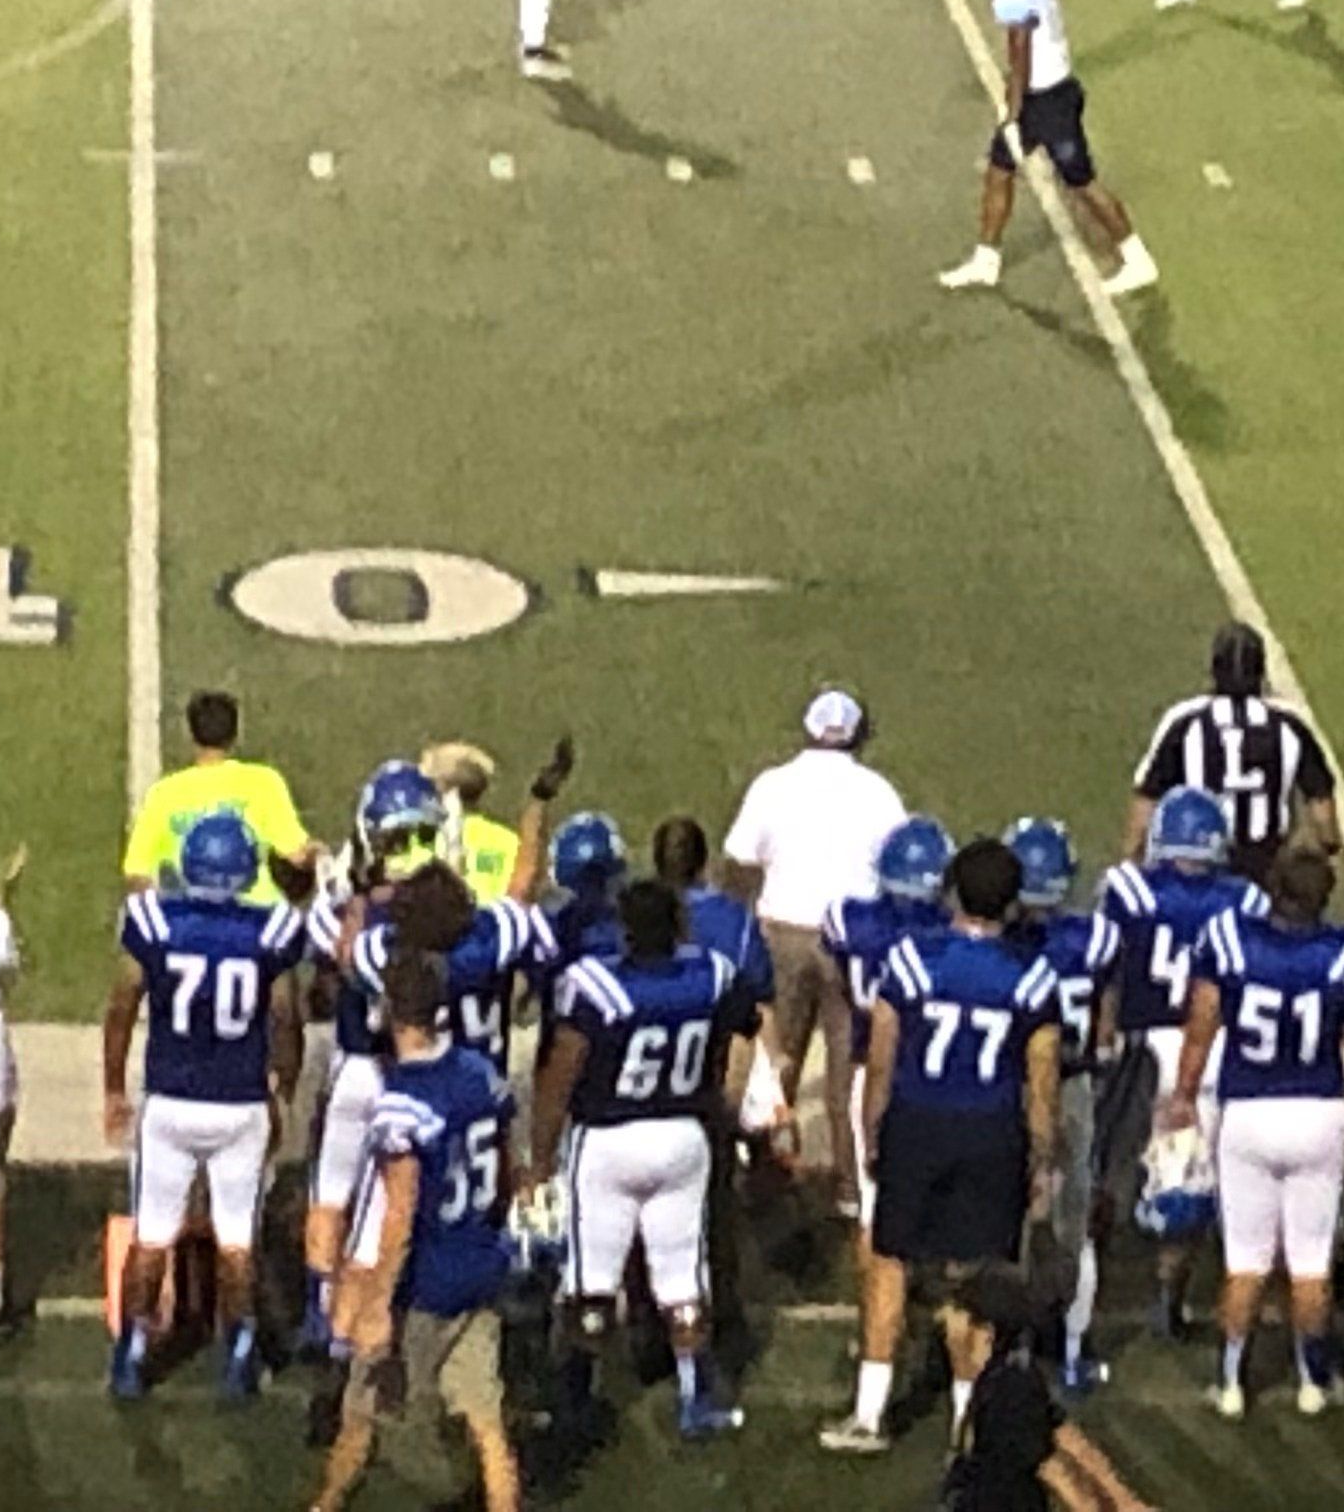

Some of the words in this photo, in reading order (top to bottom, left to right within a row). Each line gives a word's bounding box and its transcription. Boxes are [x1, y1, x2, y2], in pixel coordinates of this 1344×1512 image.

[166, 954, 258, 1038] 70
[1239, 984, 1321, 1064] 51
[615, 1019, 712, 1100] 60
[923, 1002, 1012, 1081] 77
